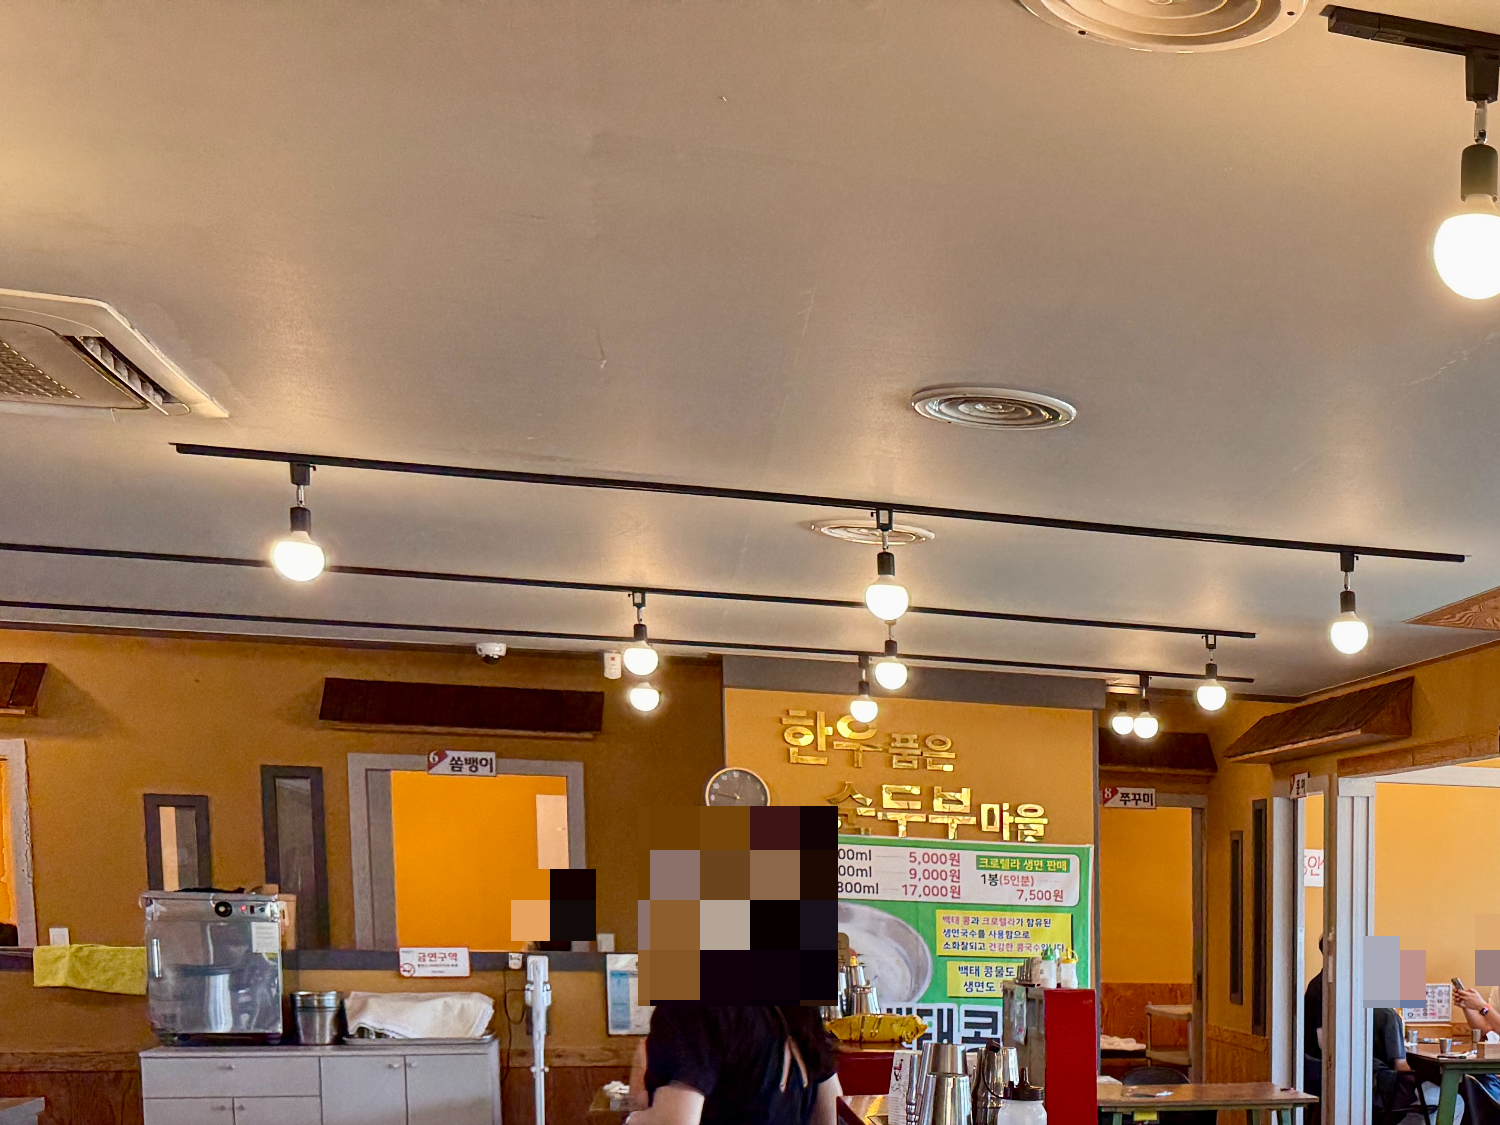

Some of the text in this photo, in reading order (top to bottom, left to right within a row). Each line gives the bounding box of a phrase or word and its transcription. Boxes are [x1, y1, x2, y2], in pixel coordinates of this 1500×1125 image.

[781, 709, 956, 771] 한우 품은
[430, 750, 438, 764] 6
[449, 756, 494, 773] 쏨뱅이
[1104, 787, 1111, 798] 8
[1120, 792, 1153, 806] 쭈꾸미
[909, 852, 961, 867] 5,000원
[1023, 858, 1044, 871] 생면
[1047, 858, 1067, 872] 판매
[909, 868, 961, 883] 9,000원
[901, 884, 961, 899] 17,000원
[1016, 889, 1064, 902] 7,500원
[958, 965, 980, 977] 백태
[963, 981, 996, 993] 생면도
